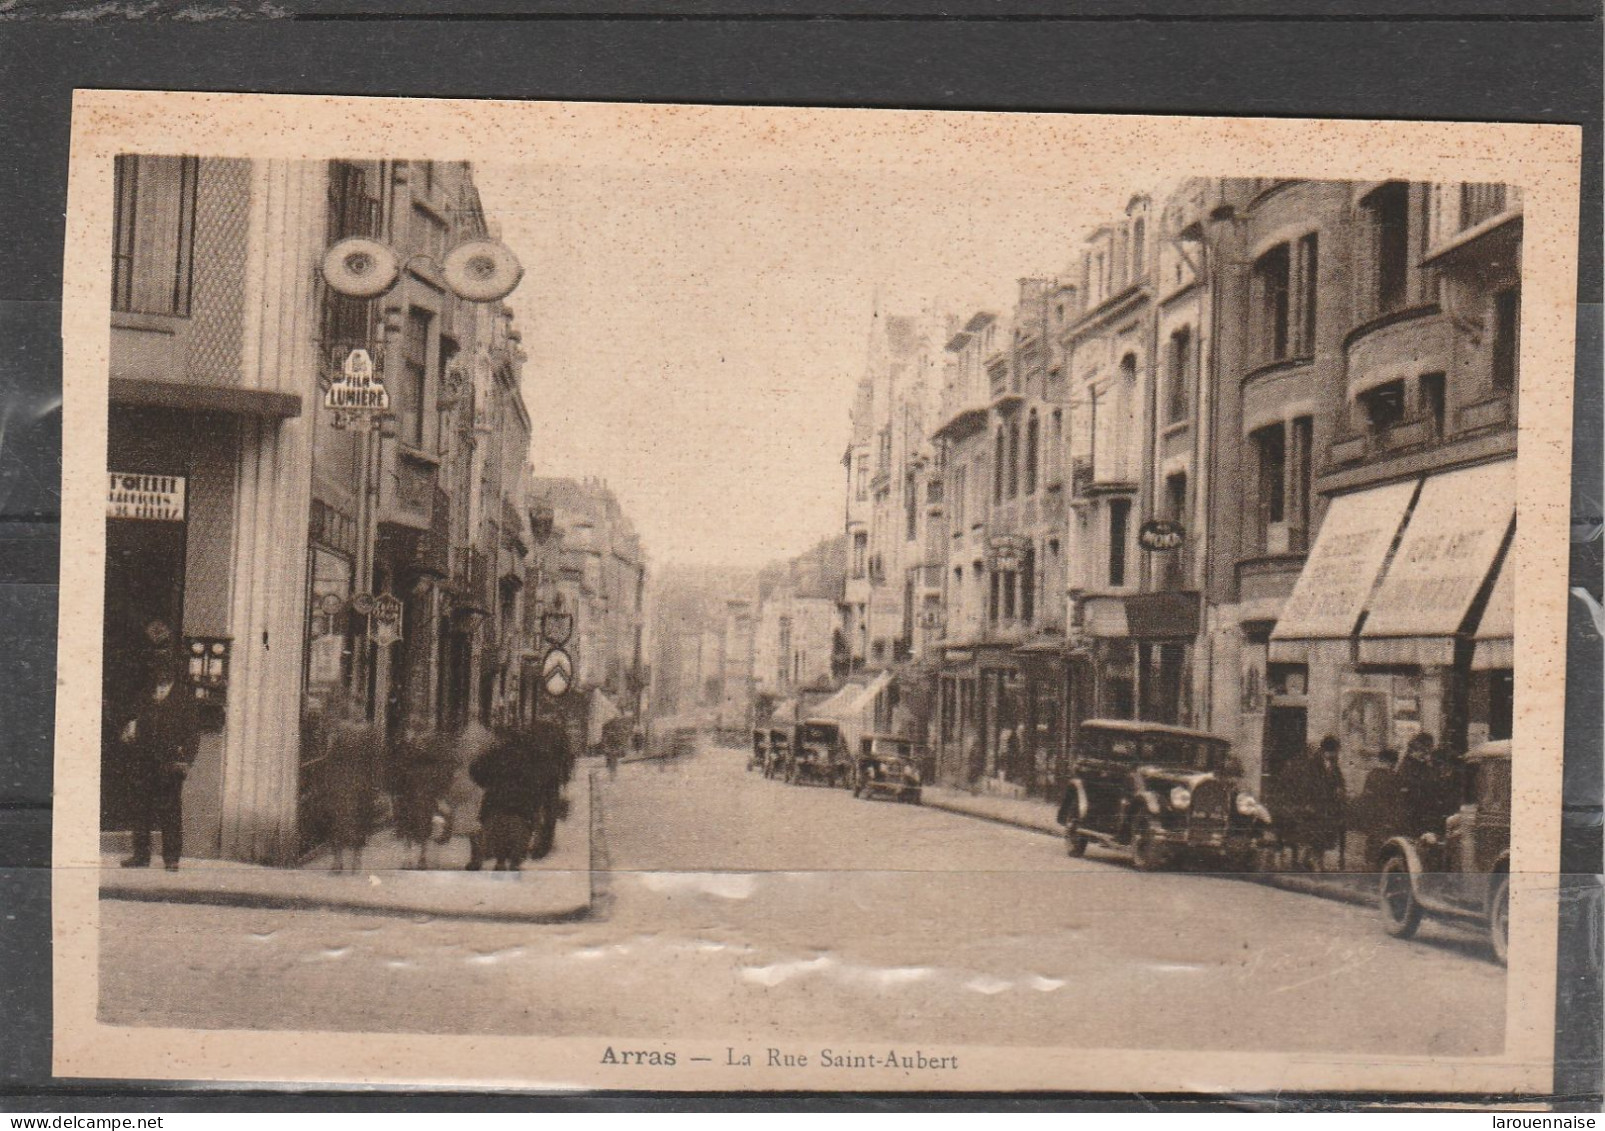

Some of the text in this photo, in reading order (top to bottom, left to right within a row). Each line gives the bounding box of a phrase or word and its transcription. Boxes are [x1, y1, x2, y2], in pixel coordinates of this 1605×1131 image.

[600, 1046, 677, 1066] Arras
[726, 1047, 751, 1066] La
[766, 1048, 808, 1067] Rue
[820, 1048, 959, 1070] Saint-Aubert
